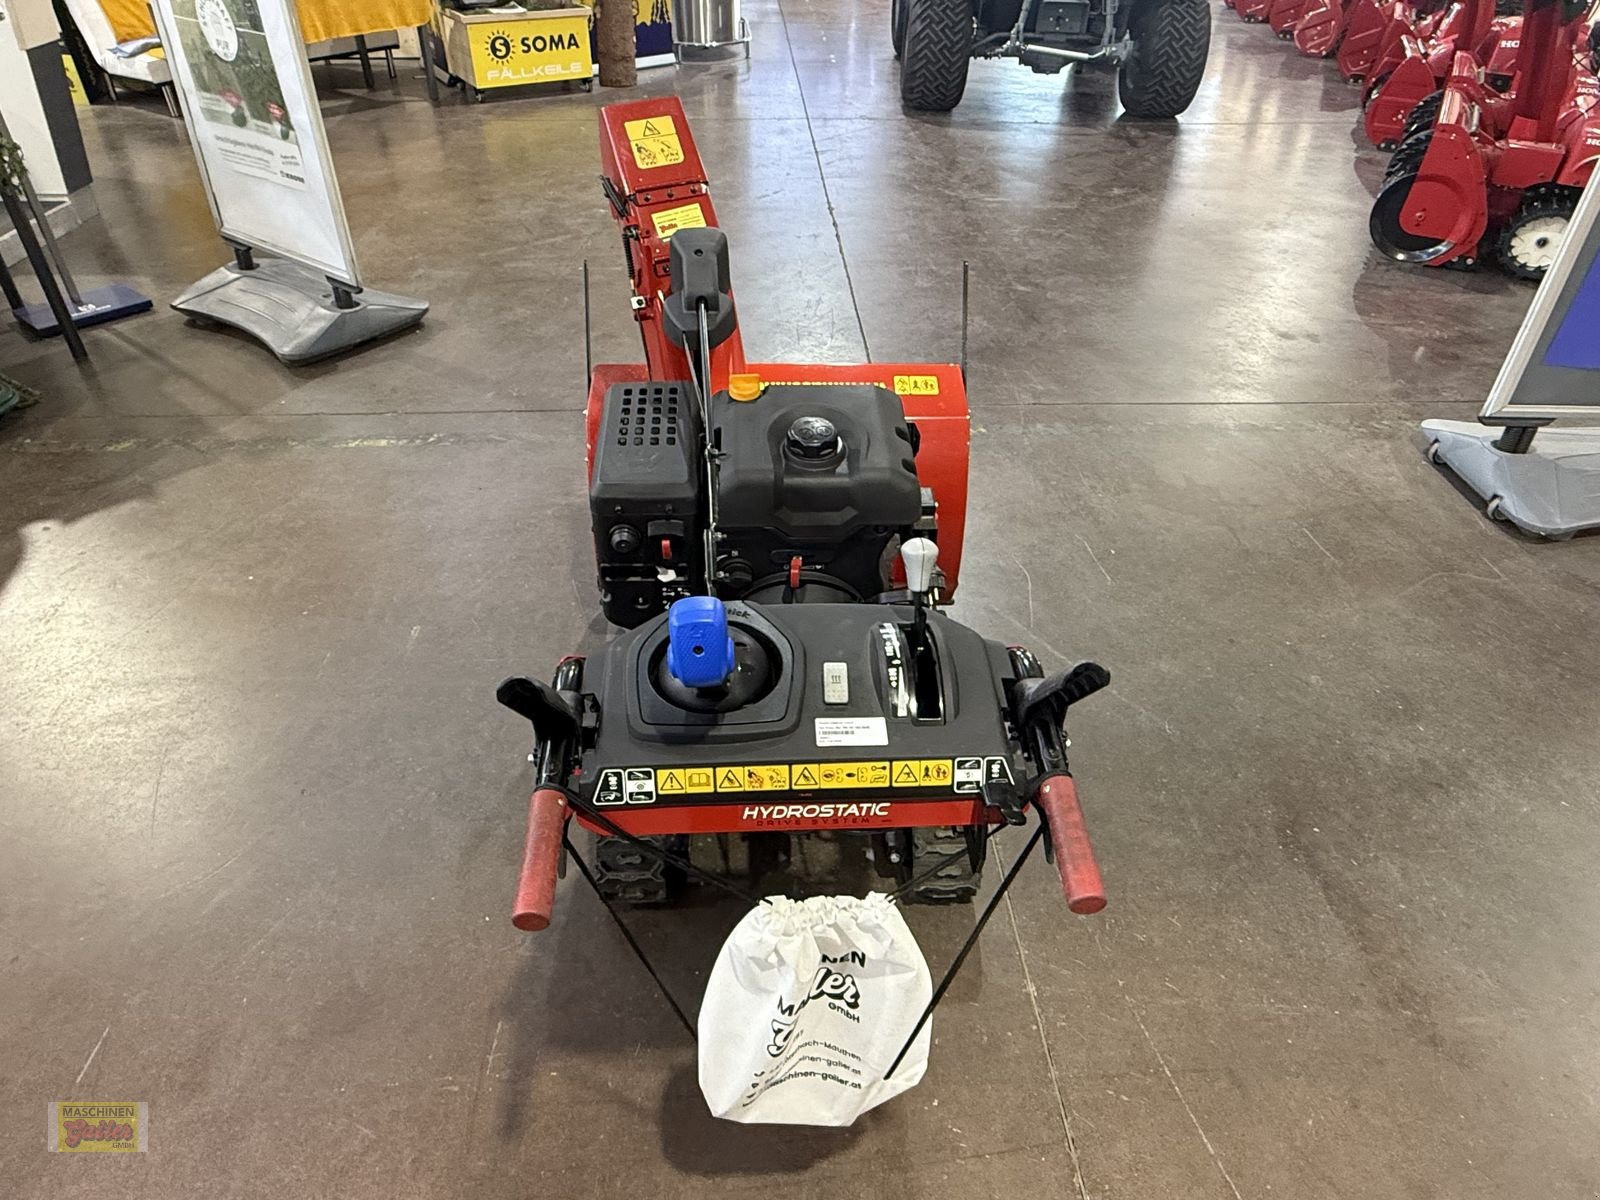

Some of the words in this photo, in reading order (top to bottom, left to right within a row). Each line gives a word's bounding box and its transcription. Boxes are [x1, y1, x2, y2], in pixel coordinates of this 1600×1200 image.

[520, 33, 580, 54] SOMA
[743, 802, 891, 820] HYDROSTATIC
[756, 818, 801, 827] DRIVE
